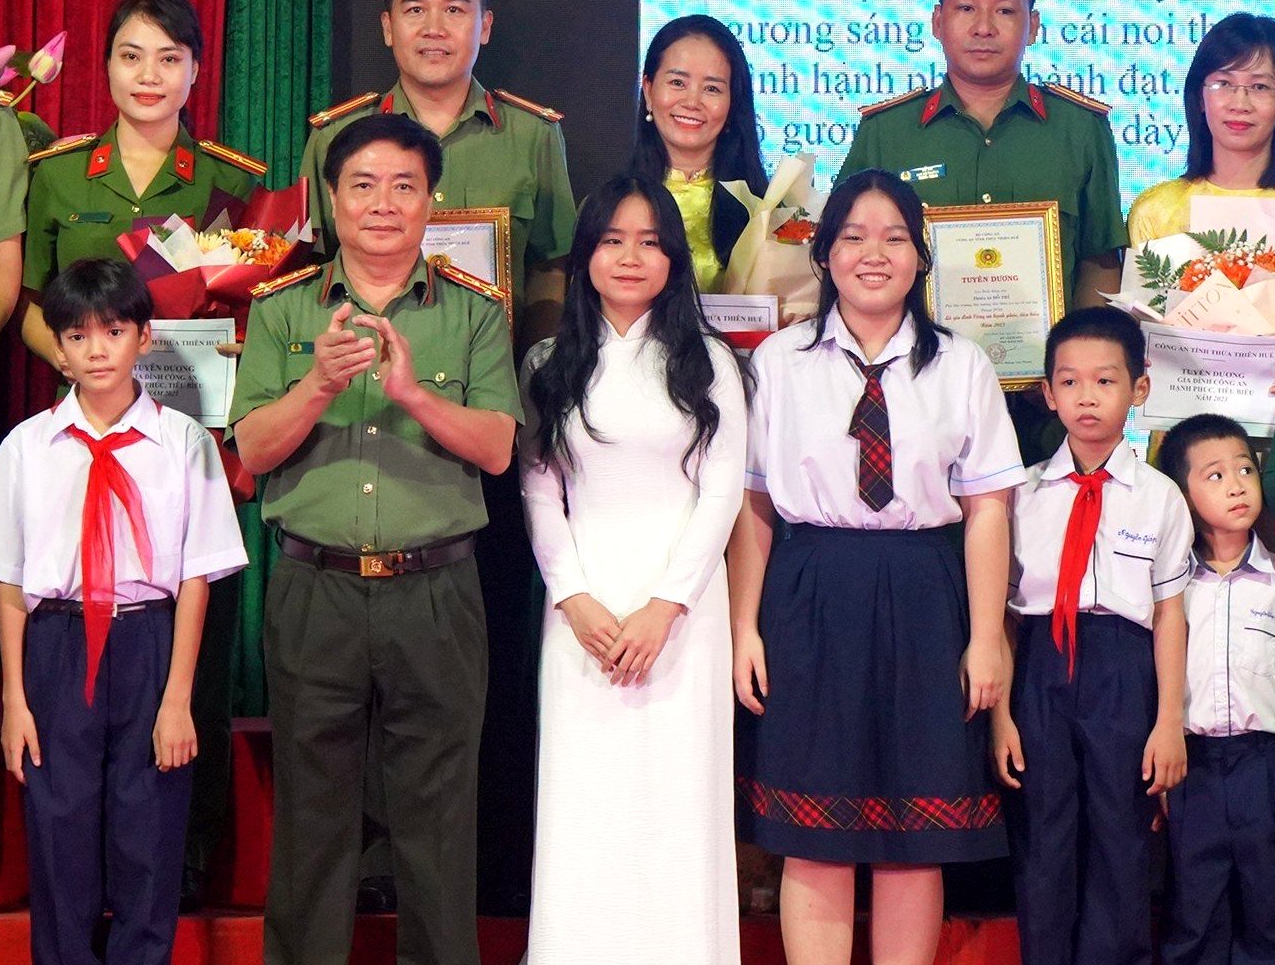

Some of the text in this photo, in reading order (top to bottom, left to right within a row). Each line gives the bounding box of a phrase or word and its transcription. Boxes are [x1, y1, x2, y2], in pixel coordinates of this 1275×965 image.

[846, 13, 925, 53] sáng
[1061, 12, 1109, 45] cái
[1121, 13, 1175, 45] noi
[812, 62, 893, 101] hạnh
[1118, 64, 1180, 102] đạt.
[782, 121, 857, 156] gươ
[1121, 114, 1183, 154] dày
